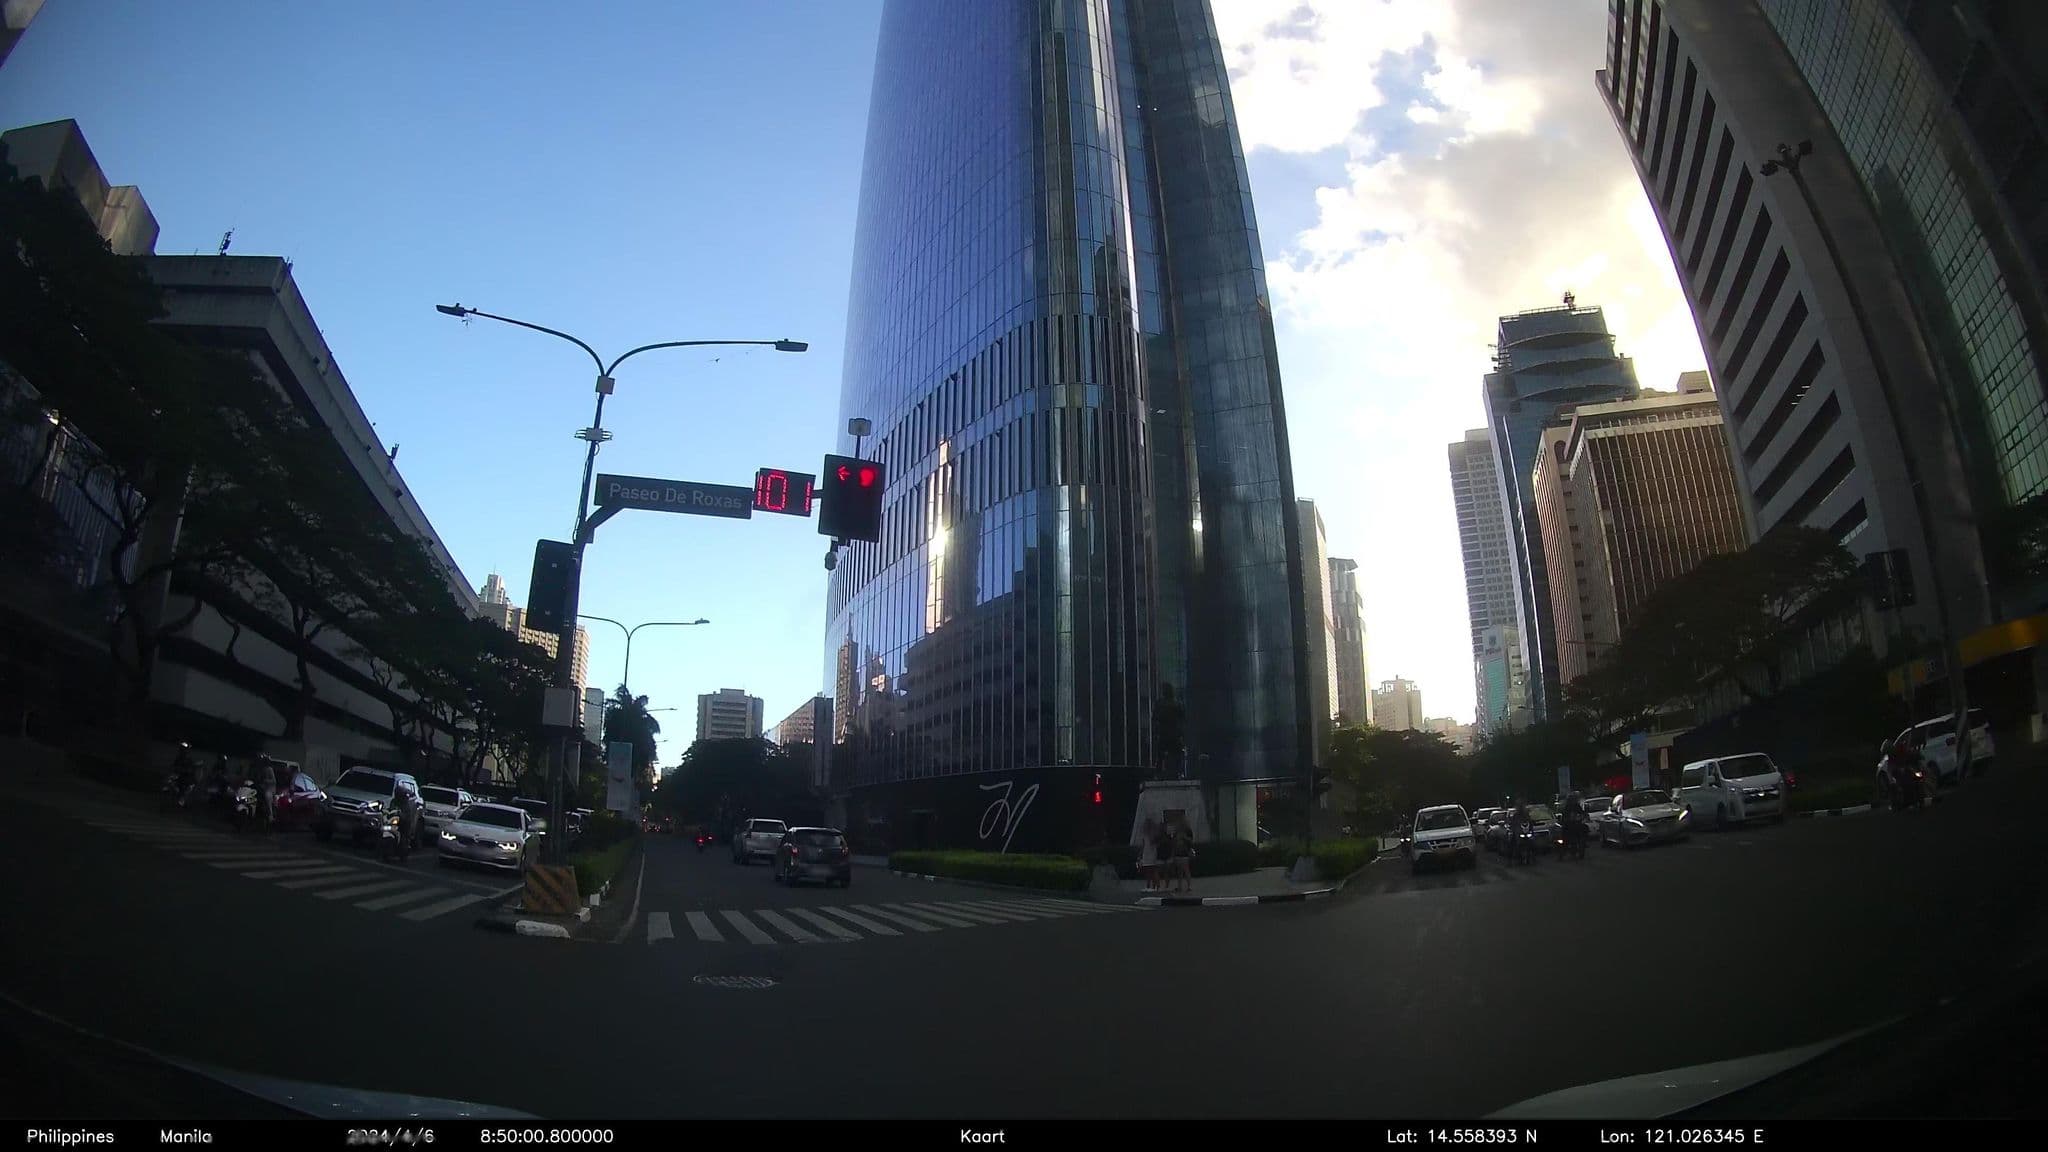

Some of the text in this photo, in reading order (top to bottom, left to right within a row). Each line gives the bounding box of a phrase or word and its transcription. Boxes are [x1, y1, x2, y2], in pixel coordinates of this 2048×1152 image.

[609, 482, 742, 509] Paseo De Roxas
[757, 471, 811, 512] 101
